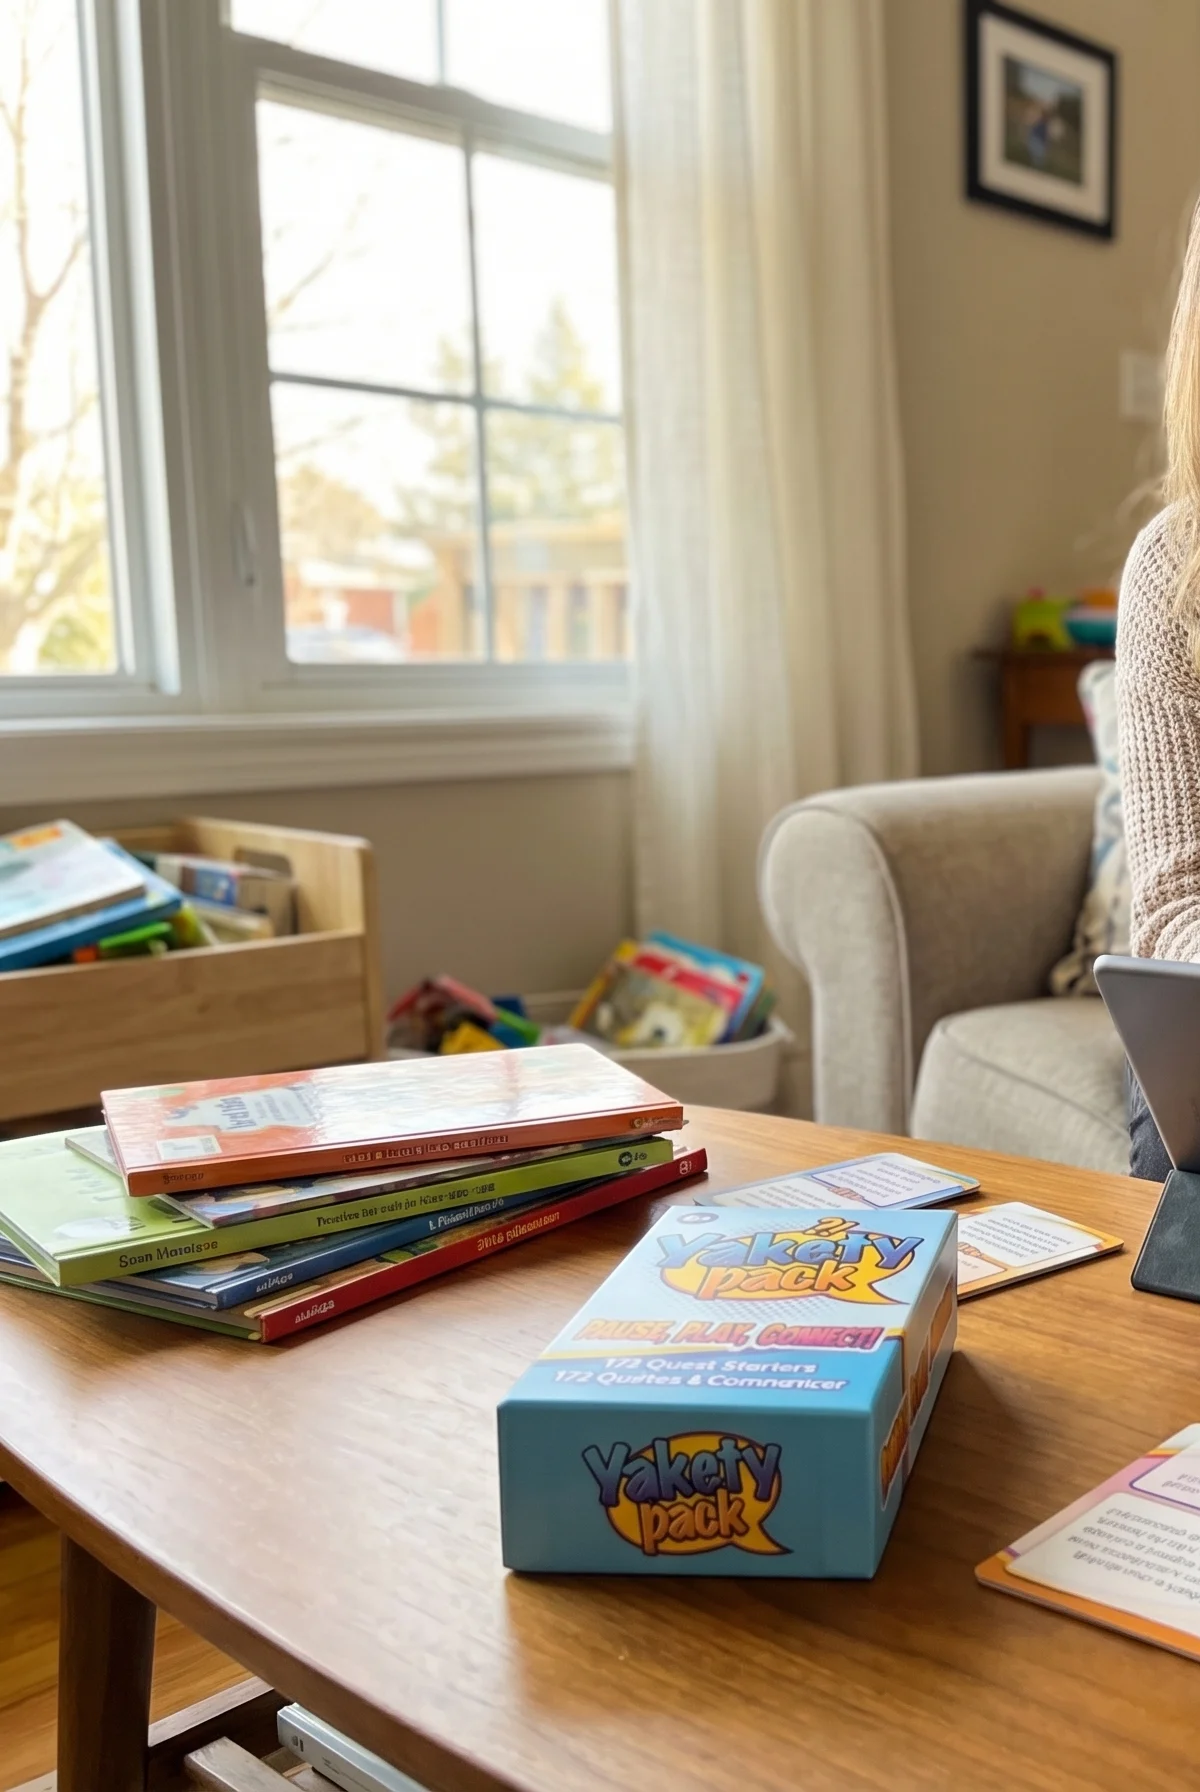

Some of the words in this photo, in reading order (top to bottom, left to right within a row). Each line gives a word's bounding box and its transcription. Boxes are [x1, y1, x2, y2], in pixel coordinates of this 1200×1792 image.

[657, 1231, 924, 1269] Yakety
[697, 1260, 859, 1300] pack
[575, 1320, 674, 1344] PAUSE,
[671, 1321, 752, 1347] PLAY,
[756, 1322, 885, 1349] CONNECT!
[555, 1370, 594, 1382] 172
[605, 1358, 642, 1369] 172
[646, 1358, 717, 1371] Quest
[721, 1360, 817, 1373] Starters
[582, 1436, 782, 1506] Yakety
[639, 1488, 750, 1556] pack
